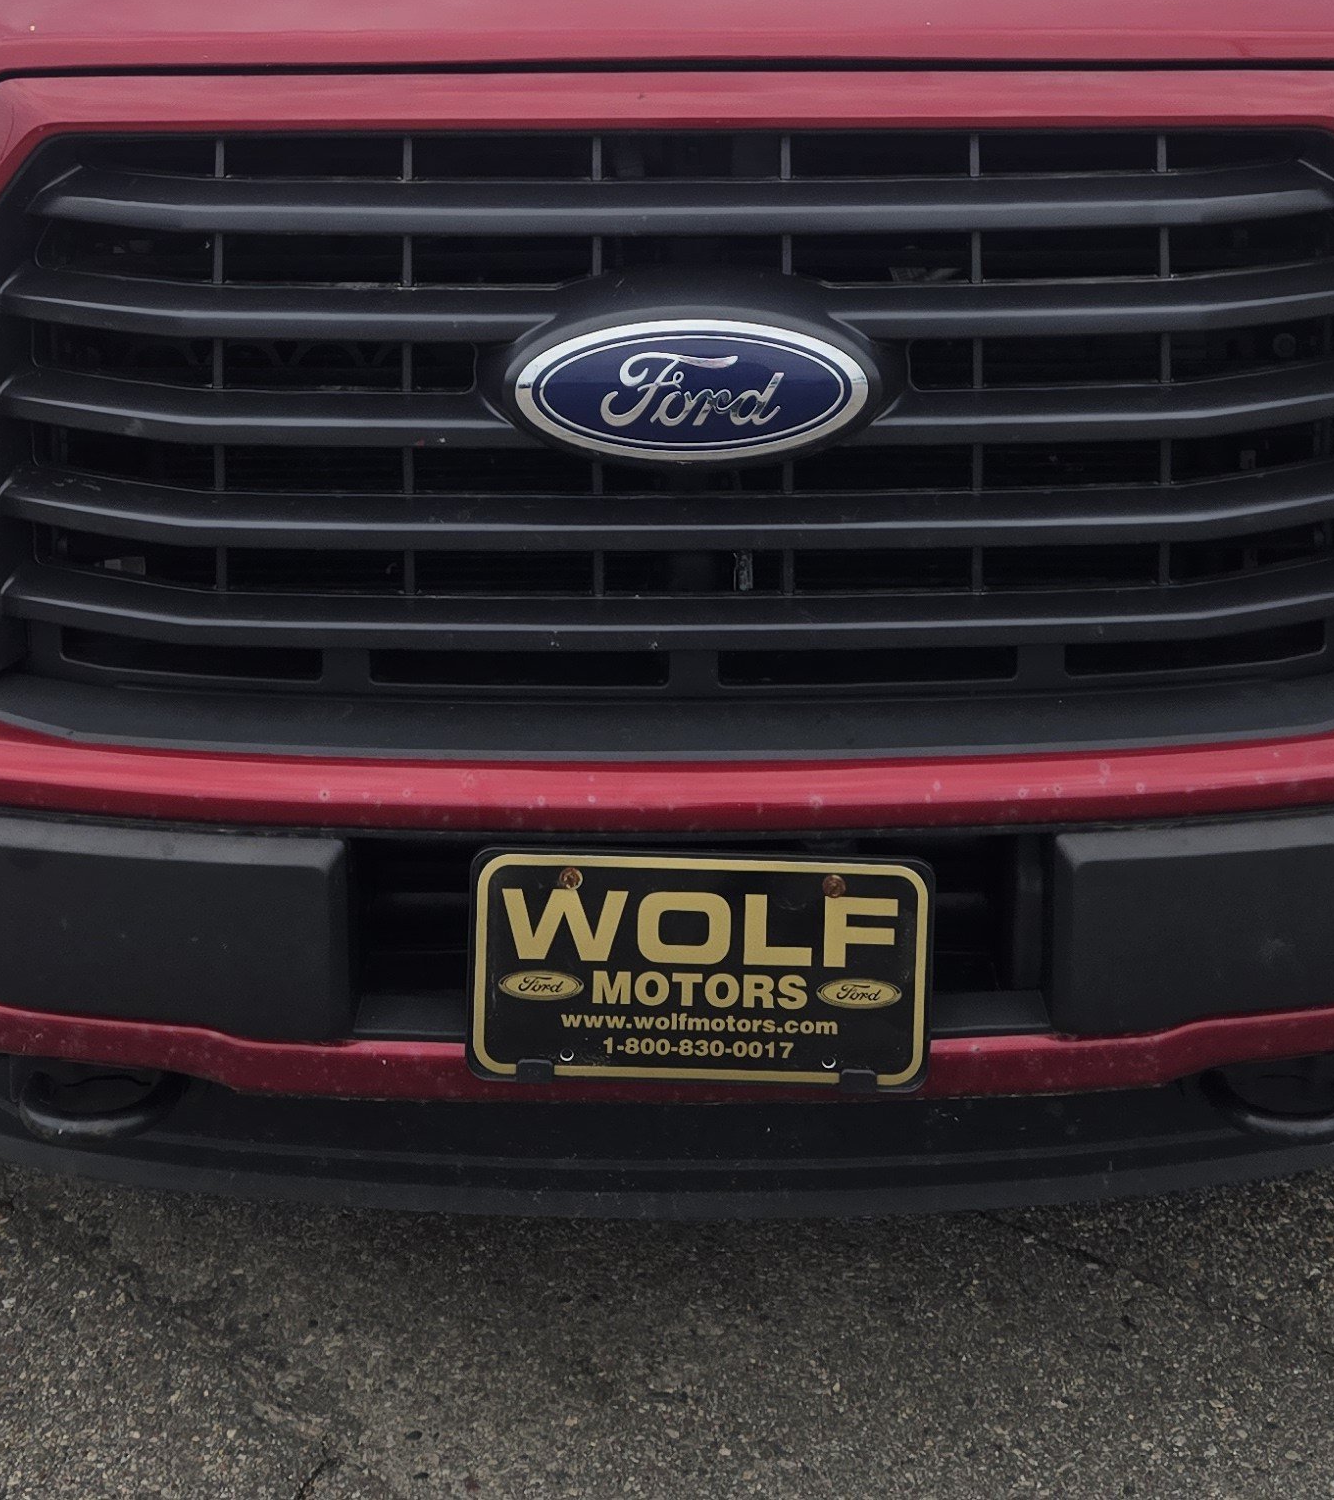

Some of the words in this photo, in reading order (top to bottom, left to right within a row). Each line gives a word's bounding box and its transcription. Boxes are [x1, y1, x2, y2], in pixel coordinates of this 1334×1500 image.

[598, 351, 786, 428] Ford
[502, 888, 899, 968] WOLF
[517, 975, 564, 994] Ford
[591, 970, 808, 1010] MOTORS
[835, 983, 882, 1002] Ford
[561, 1012, 838, 1036] www.wolfmotors.com
[603, 1037, 794, 1060] 1-800-830-0017
